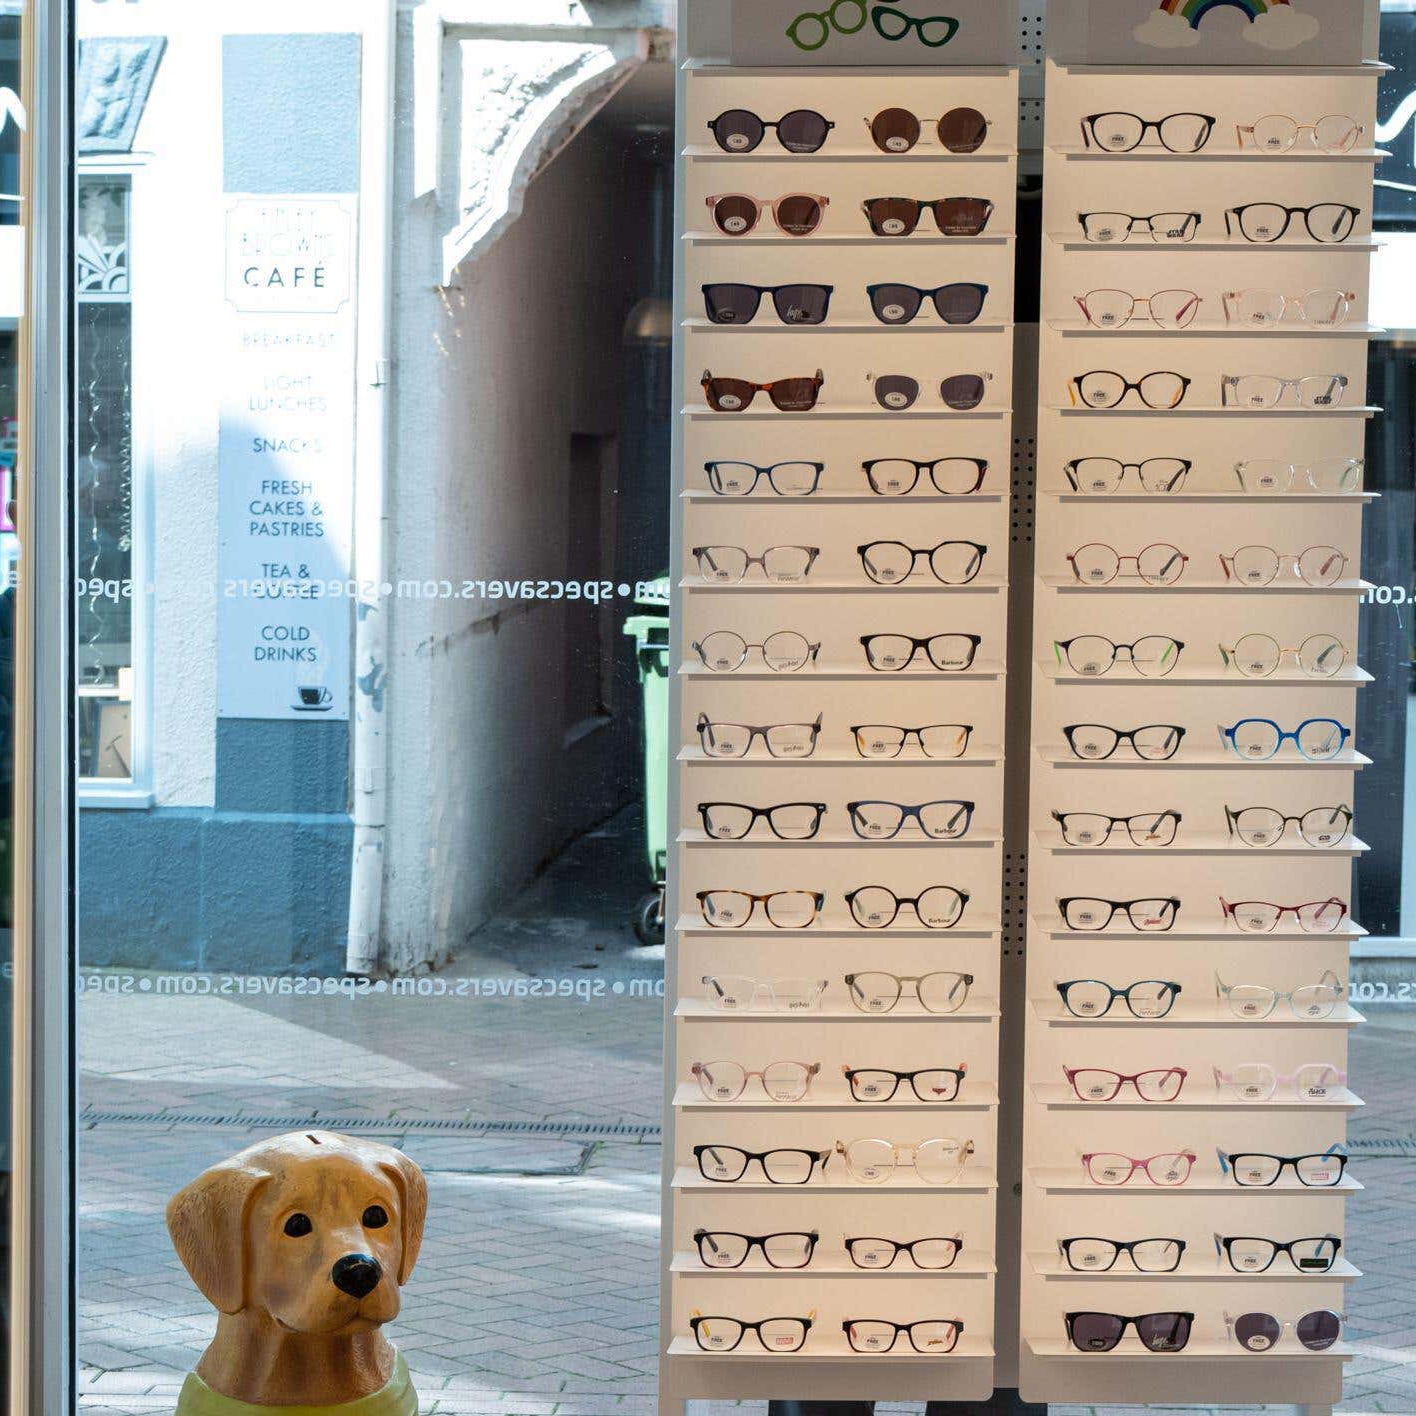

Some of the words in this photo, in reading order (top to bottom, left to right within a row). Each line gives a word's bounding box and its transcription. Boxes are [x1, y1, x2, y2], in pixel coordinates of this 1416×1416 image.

[244, 260, 325, 288] CAFÉ
[261, 480, 312, 495] FRESH
[249, 501, 305, 516] CAKES
[311, 501, 323, 516] &
[250, 522, 325, 537] PASTRIES
[261, 563, 292, 579] TEA
[298, 564, 310, 579] &
[261, 626, 310, 641] COLD
[254, 647, 317, 662] DRINKS
